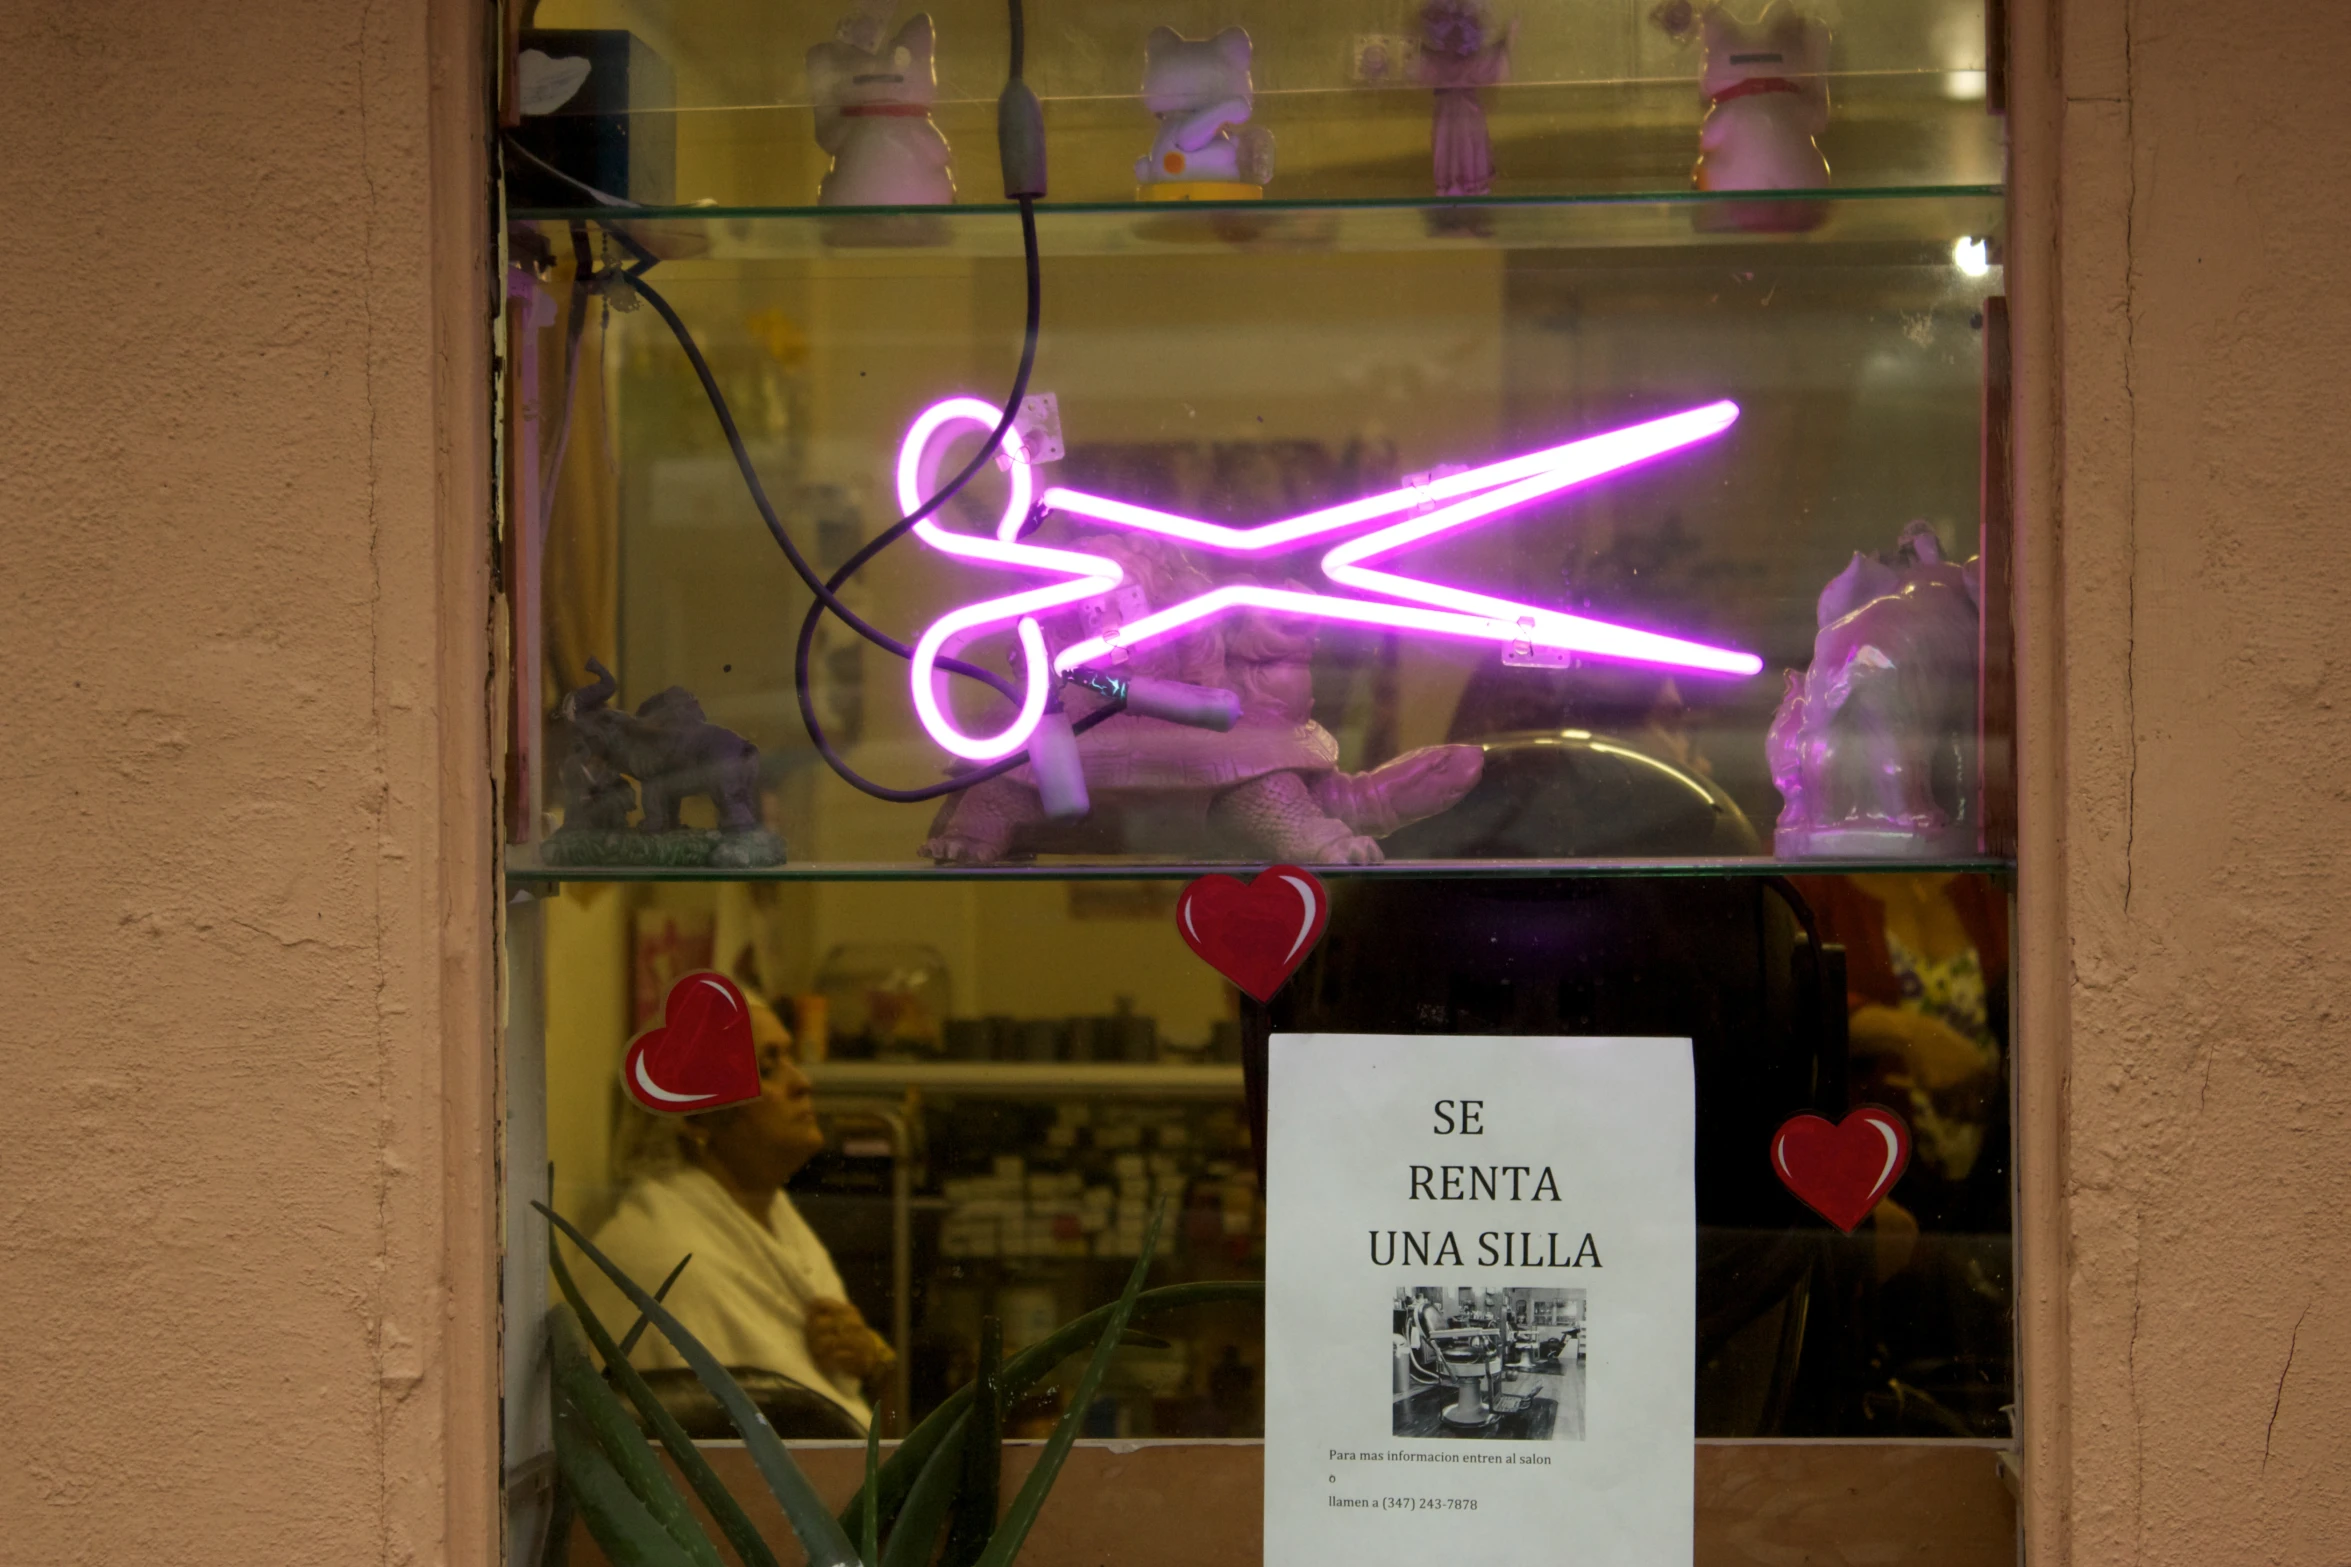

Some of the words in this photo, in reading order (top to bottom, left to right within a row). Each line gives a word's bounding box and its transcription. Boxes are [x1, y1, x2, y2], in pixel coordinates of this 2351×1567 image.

[1433, 1099, 1484, 1136] SE
[1408, 1164, 1563, 1202] RENTA
[1368, 1230, 1465, 1267] UNA
[1477, 1230, 1604, 1269] SILLA
[1329, 1449, 1356, 1462] Para
[1359, 1452, 1384, 1462] mas
[1387, 1449, 1460, 1463] informacion
[1462, 1453, 1503, 1464] entren
[1505, 1452, 1516, 1465] al
[1519, 1452, 1552, 1465] salon
[1328, 1495, 1369, 1508] llamen
[1371, 1499, 1379, 1509] a
[1382, 1496, 1416, 1512] (347)
[1419, 1497, 1478, 1511] 243-7878
